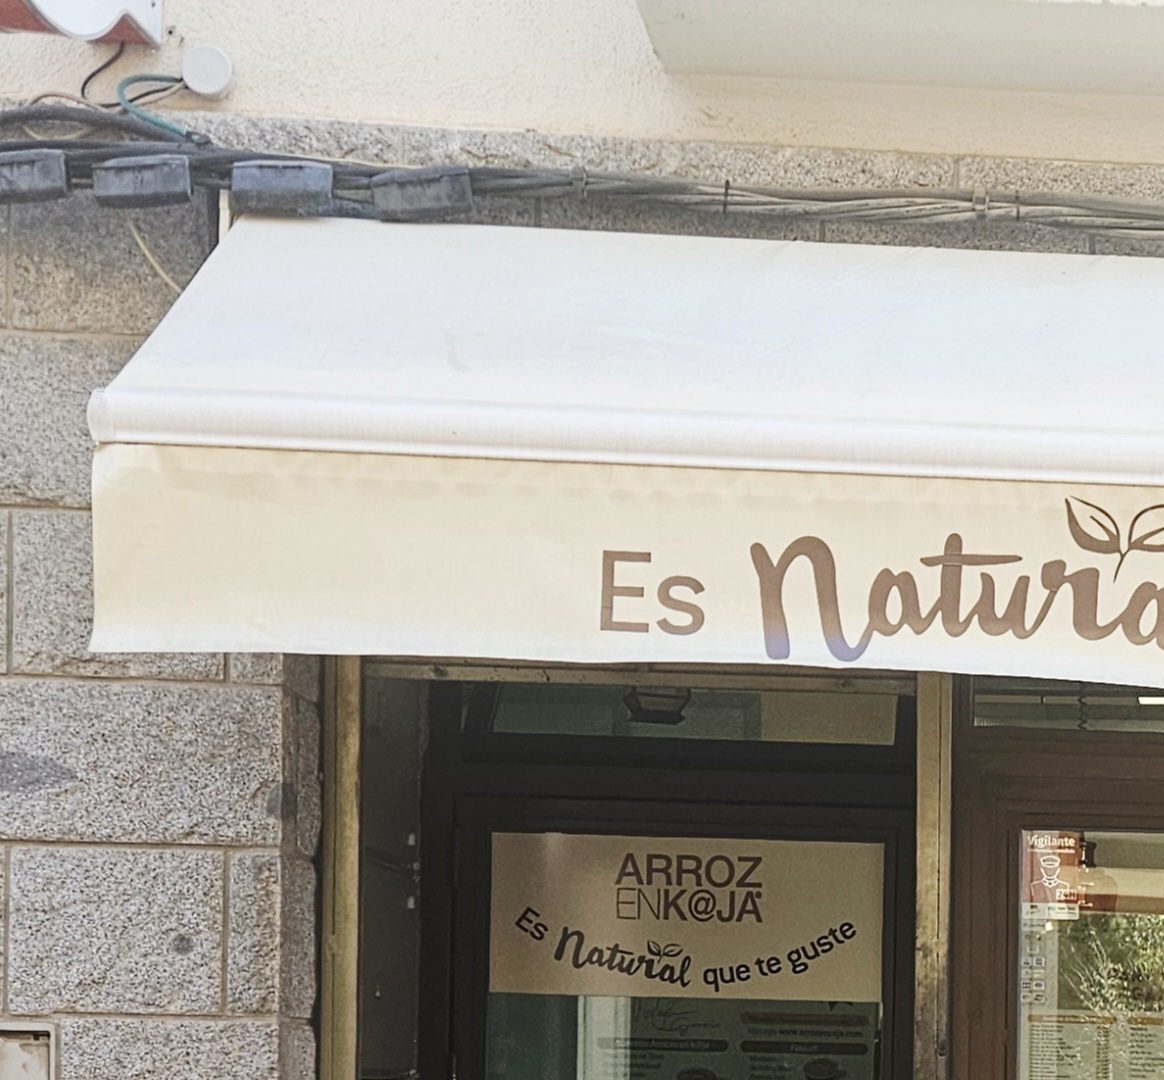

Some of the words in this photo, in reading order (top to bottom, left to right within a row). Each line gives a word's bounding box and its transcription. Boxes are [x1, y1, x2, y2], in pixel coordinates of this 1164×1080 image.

[599, 549, 706, 635] Es
[616, 853, 762, 888] ARROZ
[1028, 835, 1075, 848] Vigilante
[515, 907, 548, 941] Es
[554, 926, 690, 987] Natural
[703, 964, 750, 992] que
[755, 956, 782, 976] te
[788, 922, 856, 974] guste
